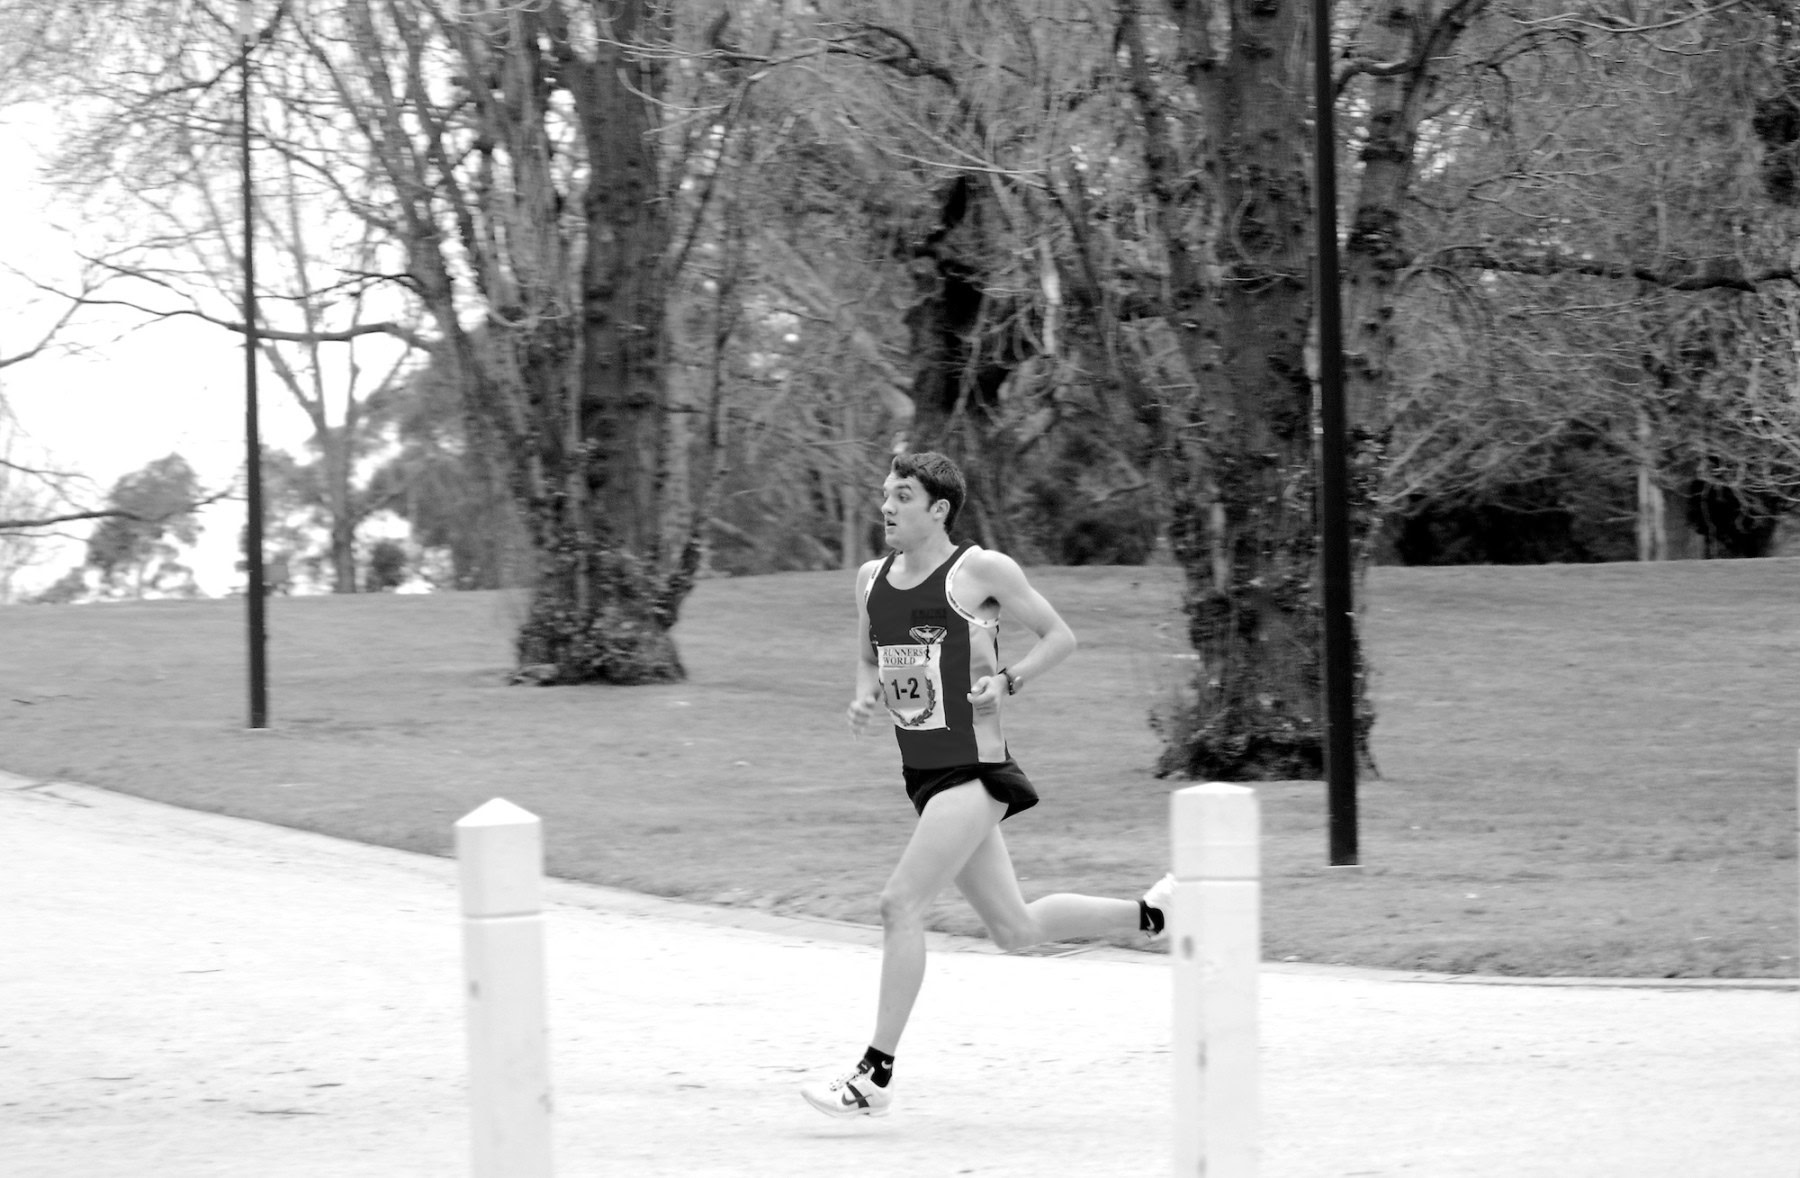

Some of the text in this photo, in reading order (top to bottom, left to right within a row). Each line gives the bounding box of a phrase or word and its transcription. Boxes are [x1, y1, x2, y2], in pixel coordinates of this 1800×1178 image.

[883, 648, 924, 657] RUNNERS
[883, 656, 916, 665] WORLD
[891, 677, 920, 700] 1-2
